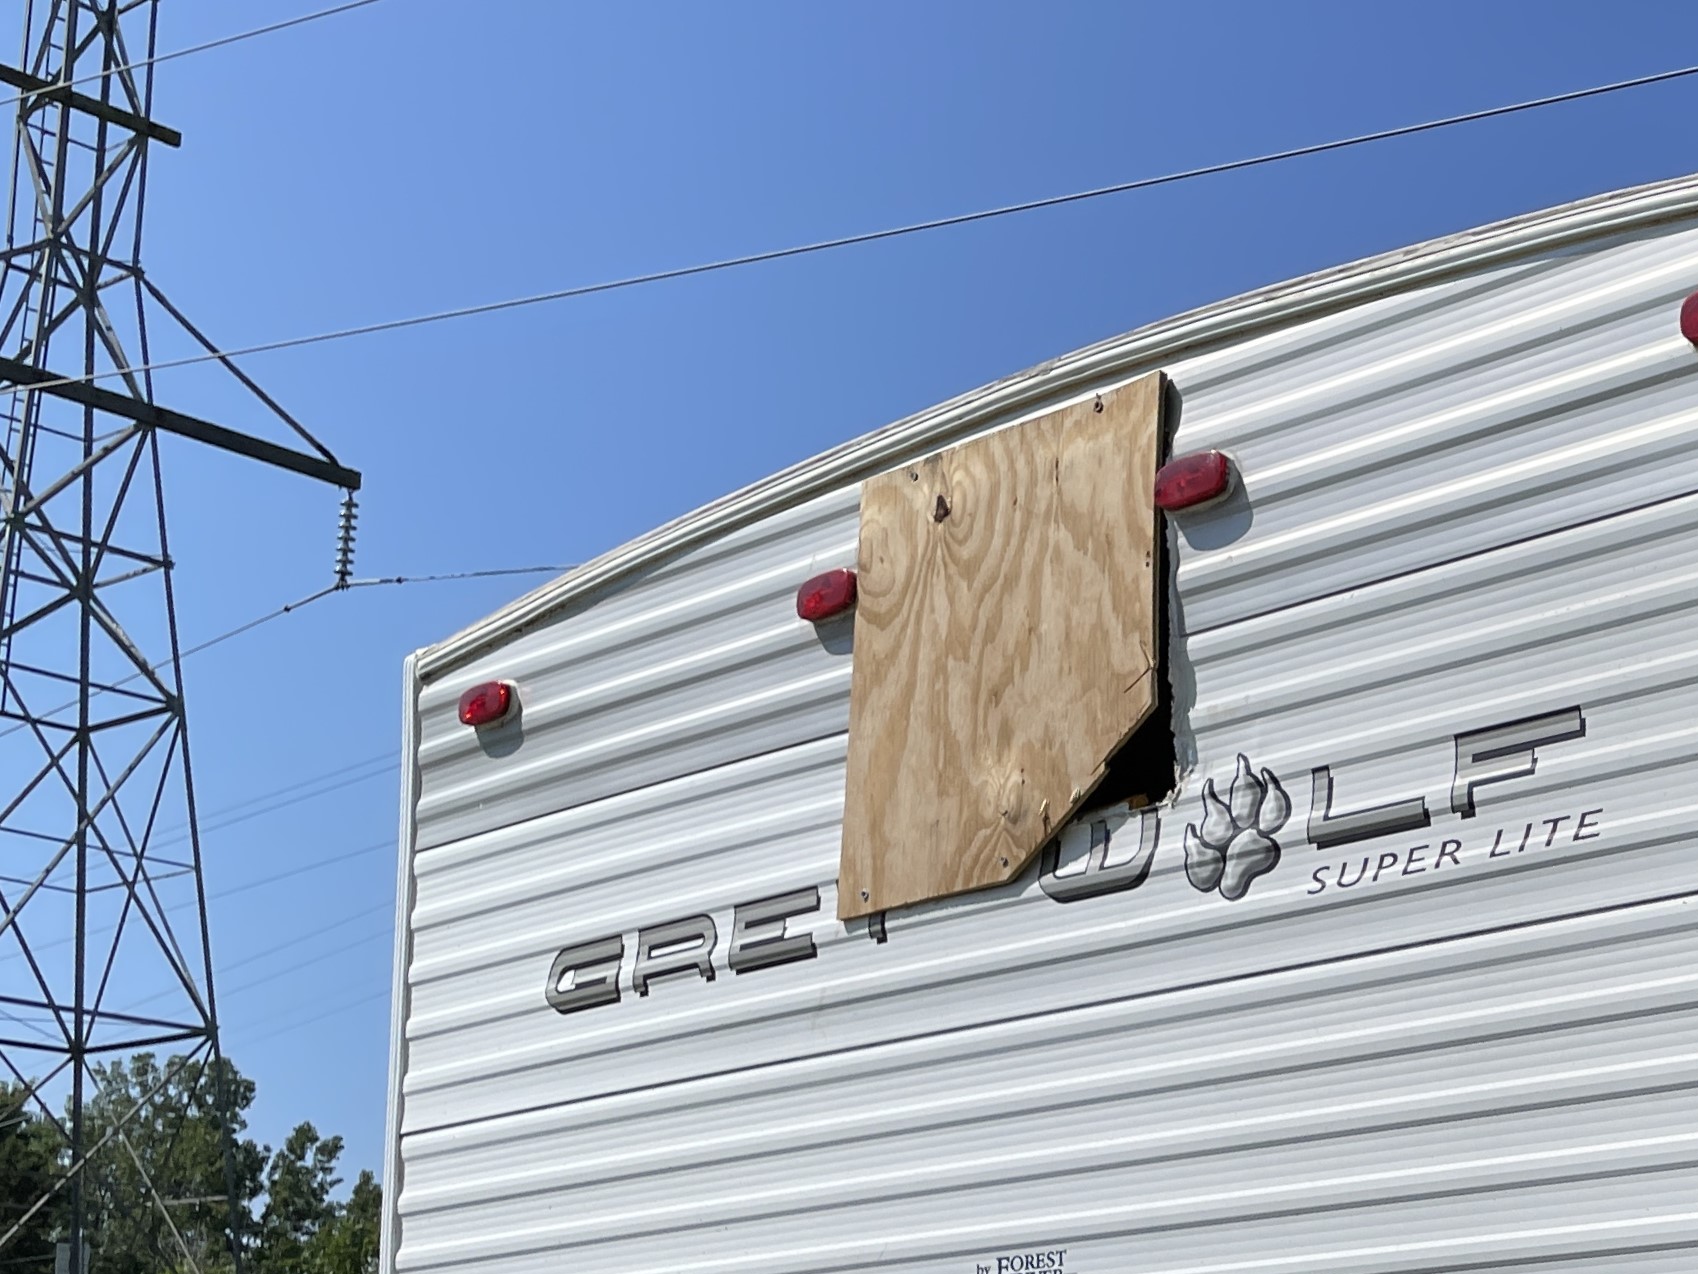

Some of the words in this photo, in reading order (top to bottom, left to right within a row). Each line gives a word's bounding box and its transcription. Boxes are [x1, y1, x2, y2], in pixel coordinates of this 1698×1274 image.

[1306, 837, 1463, 895] SUPER
[1488, 807, 1604, 860] LITE
[545, 880, 888, 1016] GRE
